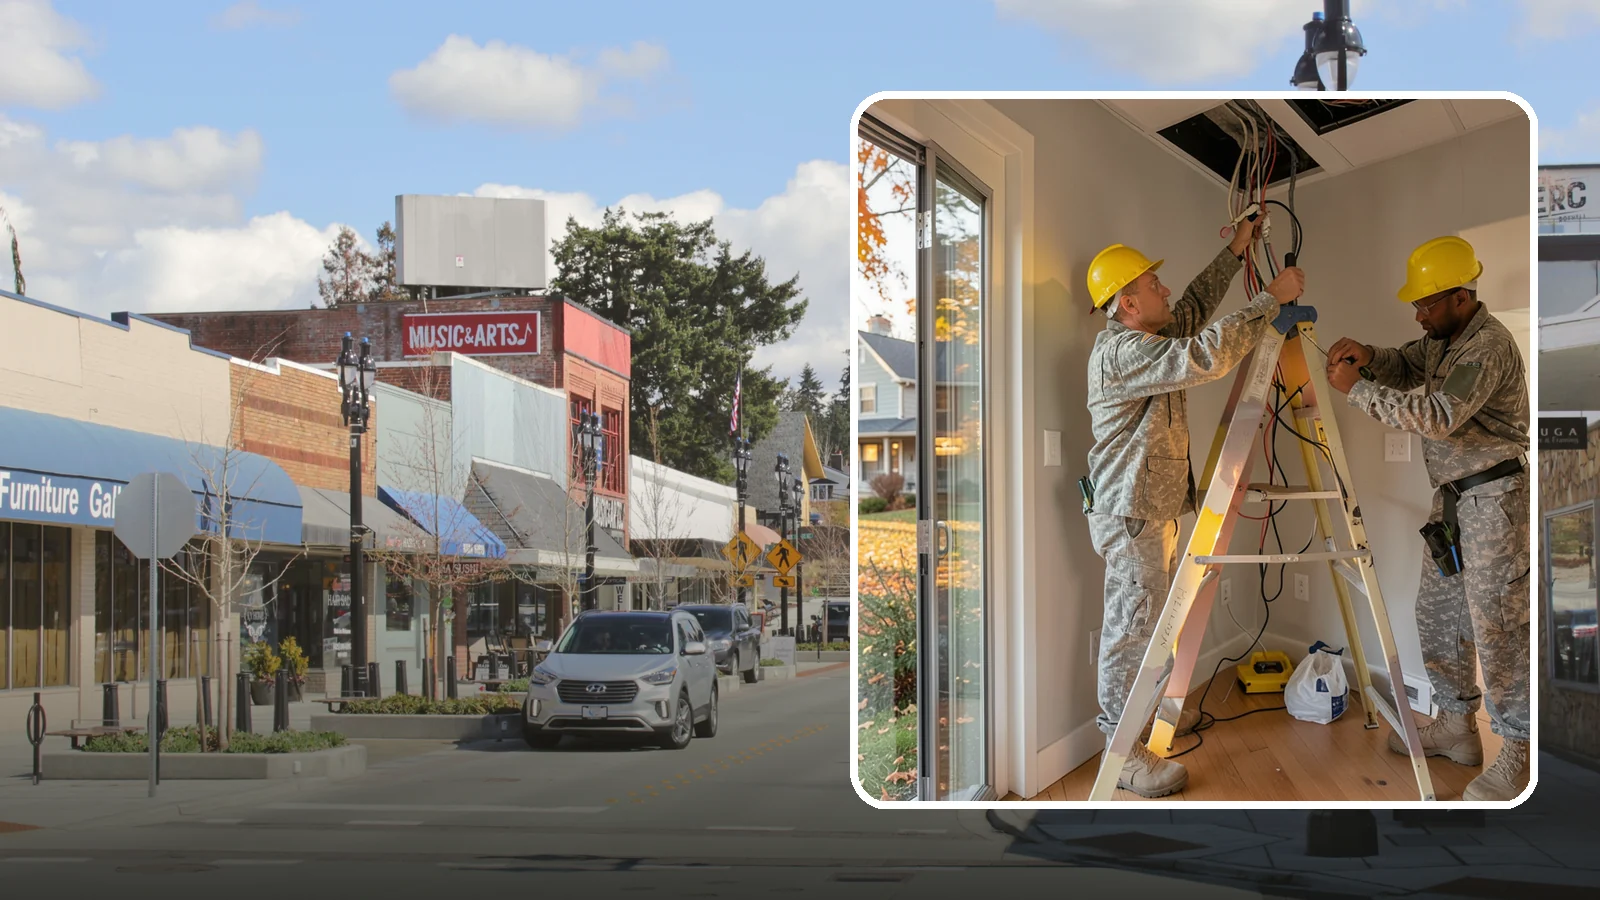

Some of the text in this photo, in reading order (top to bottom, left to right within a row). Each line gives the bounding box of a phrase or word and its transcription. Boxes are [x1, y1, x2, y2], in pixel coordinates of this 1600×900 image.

[408, 322, 520, 349] MUSIC&ARTS
[1540, 427, 1577, 437] UGA
[0, 471, 79, 516] Furniture
[453, 563, 479, 574] SUSHI
